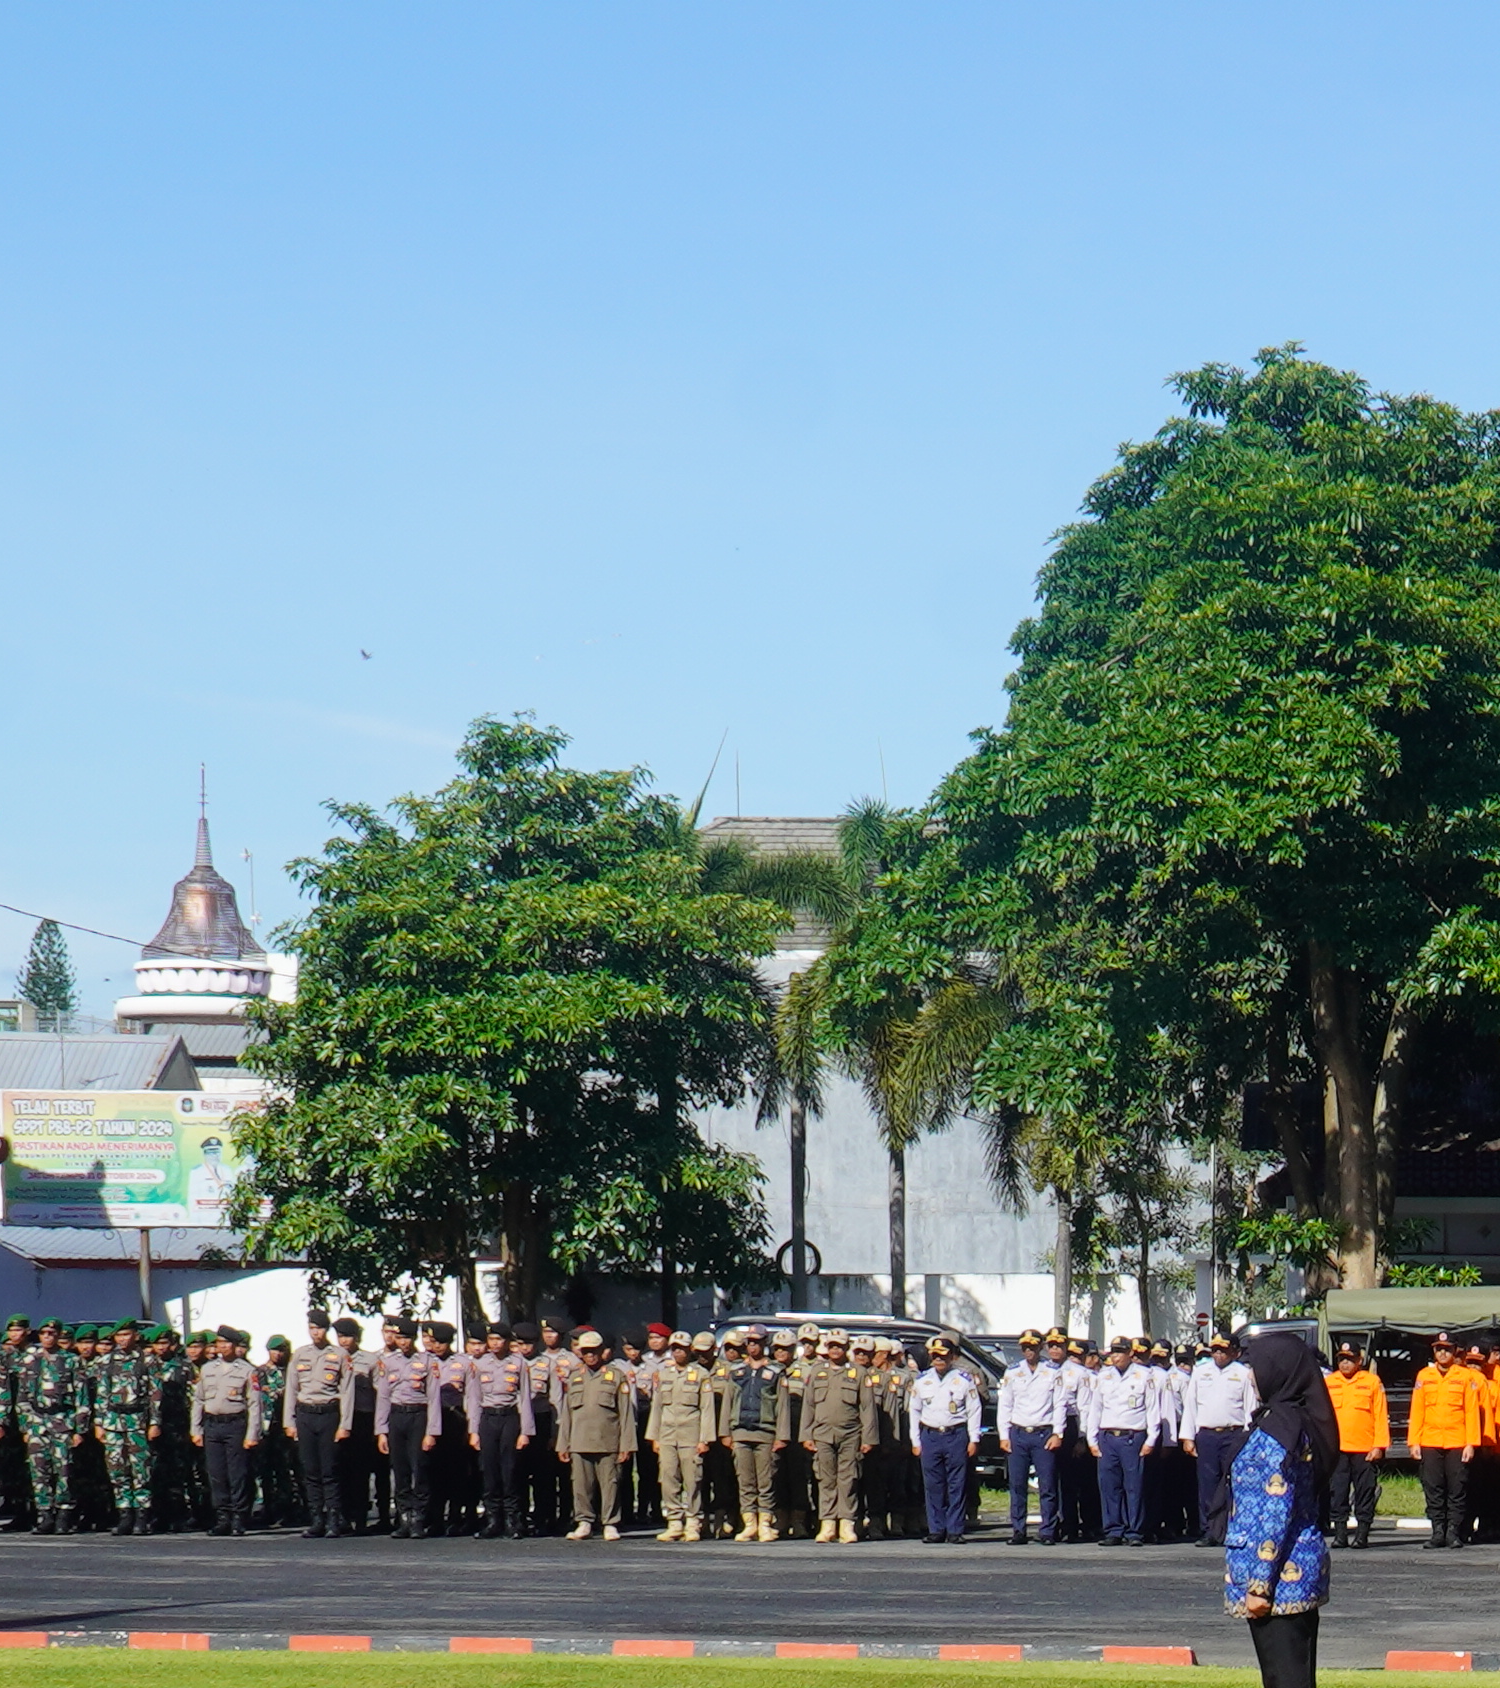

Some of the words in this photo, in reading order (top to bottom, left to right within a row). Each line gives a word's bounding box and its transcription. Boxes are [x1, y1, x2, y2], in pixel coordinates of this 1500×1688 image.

[12, 1099, 50, 1115] TELAH
[53, 1099, 95, 1115] TERBIT
[13, 1119, 45, 1135] SPPT
[47, 1119, 92, 1136] PBB-P2
[95, 1120, 136, 1136] TAHUN
[138, 1120, 173, 1137] 2024
[13, 1142, 64, 1151] PASTIKAN
[66, 1142, 95, 1151] ANDA
[97, 1142, 175, 1151] MENERIMANYA
